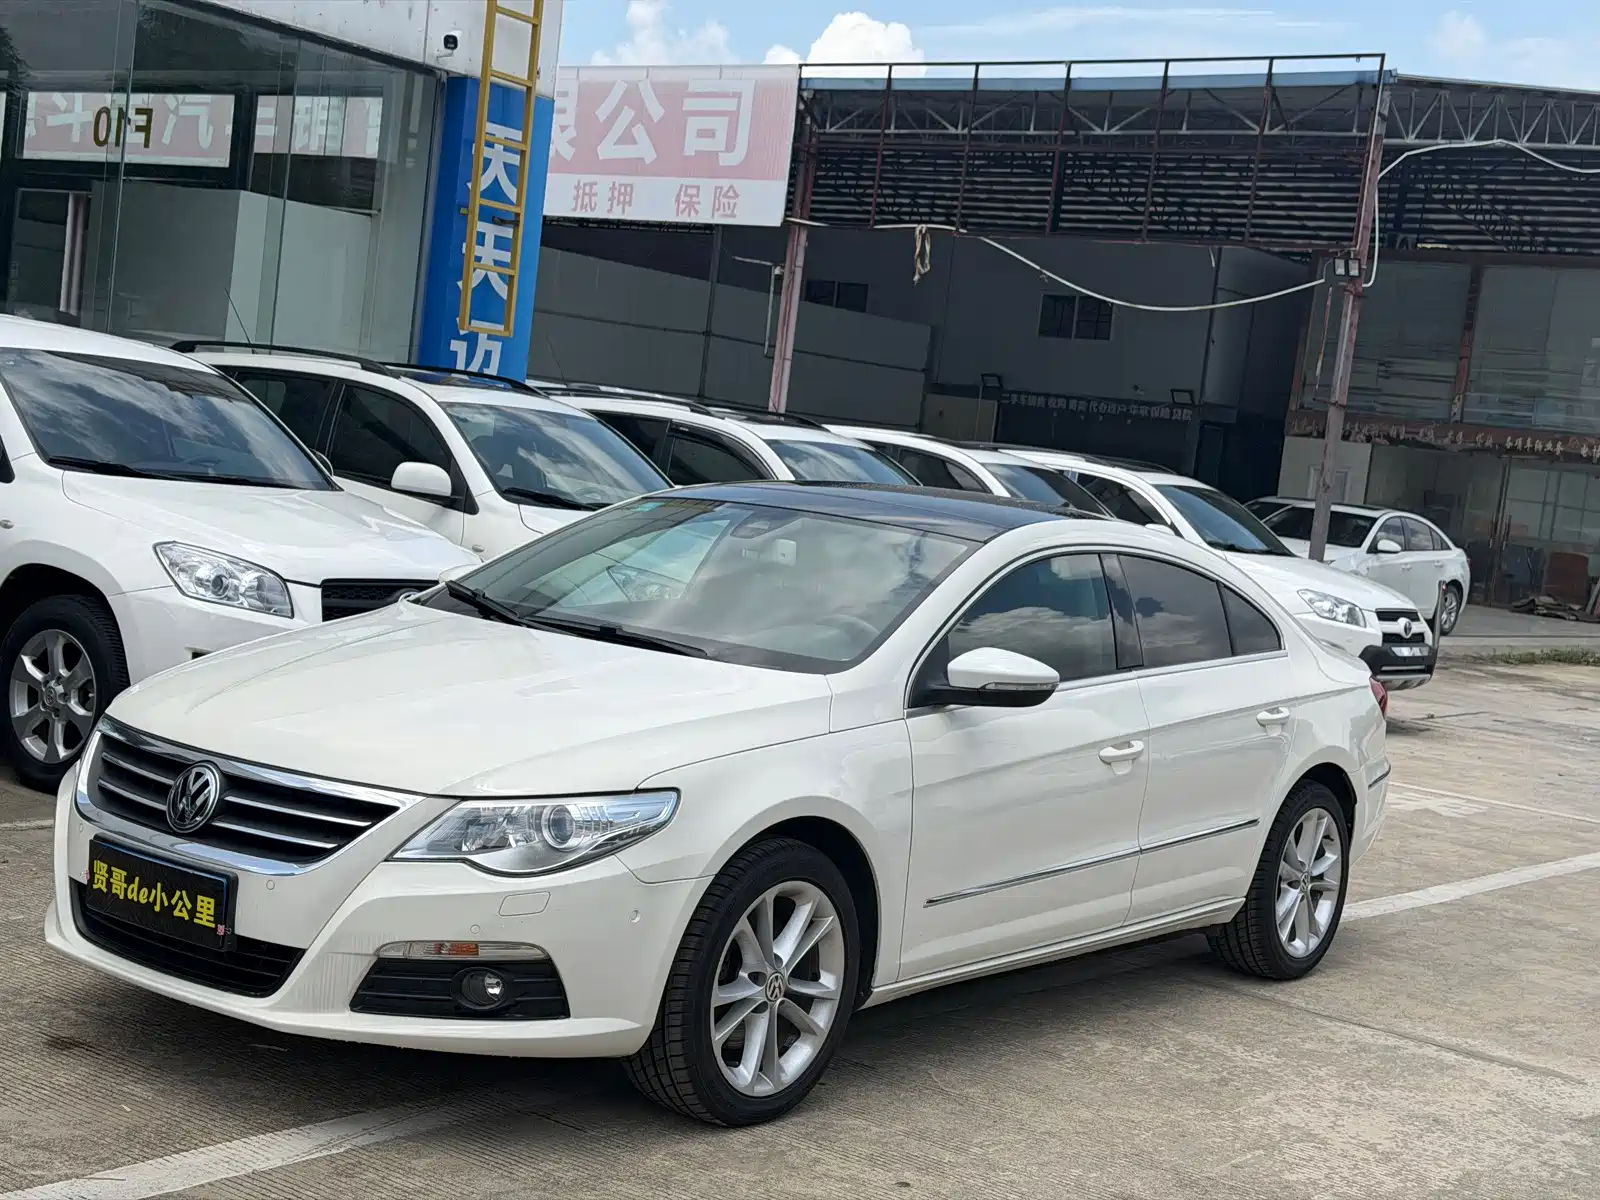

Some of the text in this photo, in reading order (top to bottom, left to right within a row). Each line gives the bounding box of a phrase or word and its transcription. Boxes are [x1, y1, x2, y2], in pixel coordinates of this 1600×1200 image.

[572, 179, 740, 219] 抵押 保险
[92, 859, 216, 929] 贤哥de小公里
